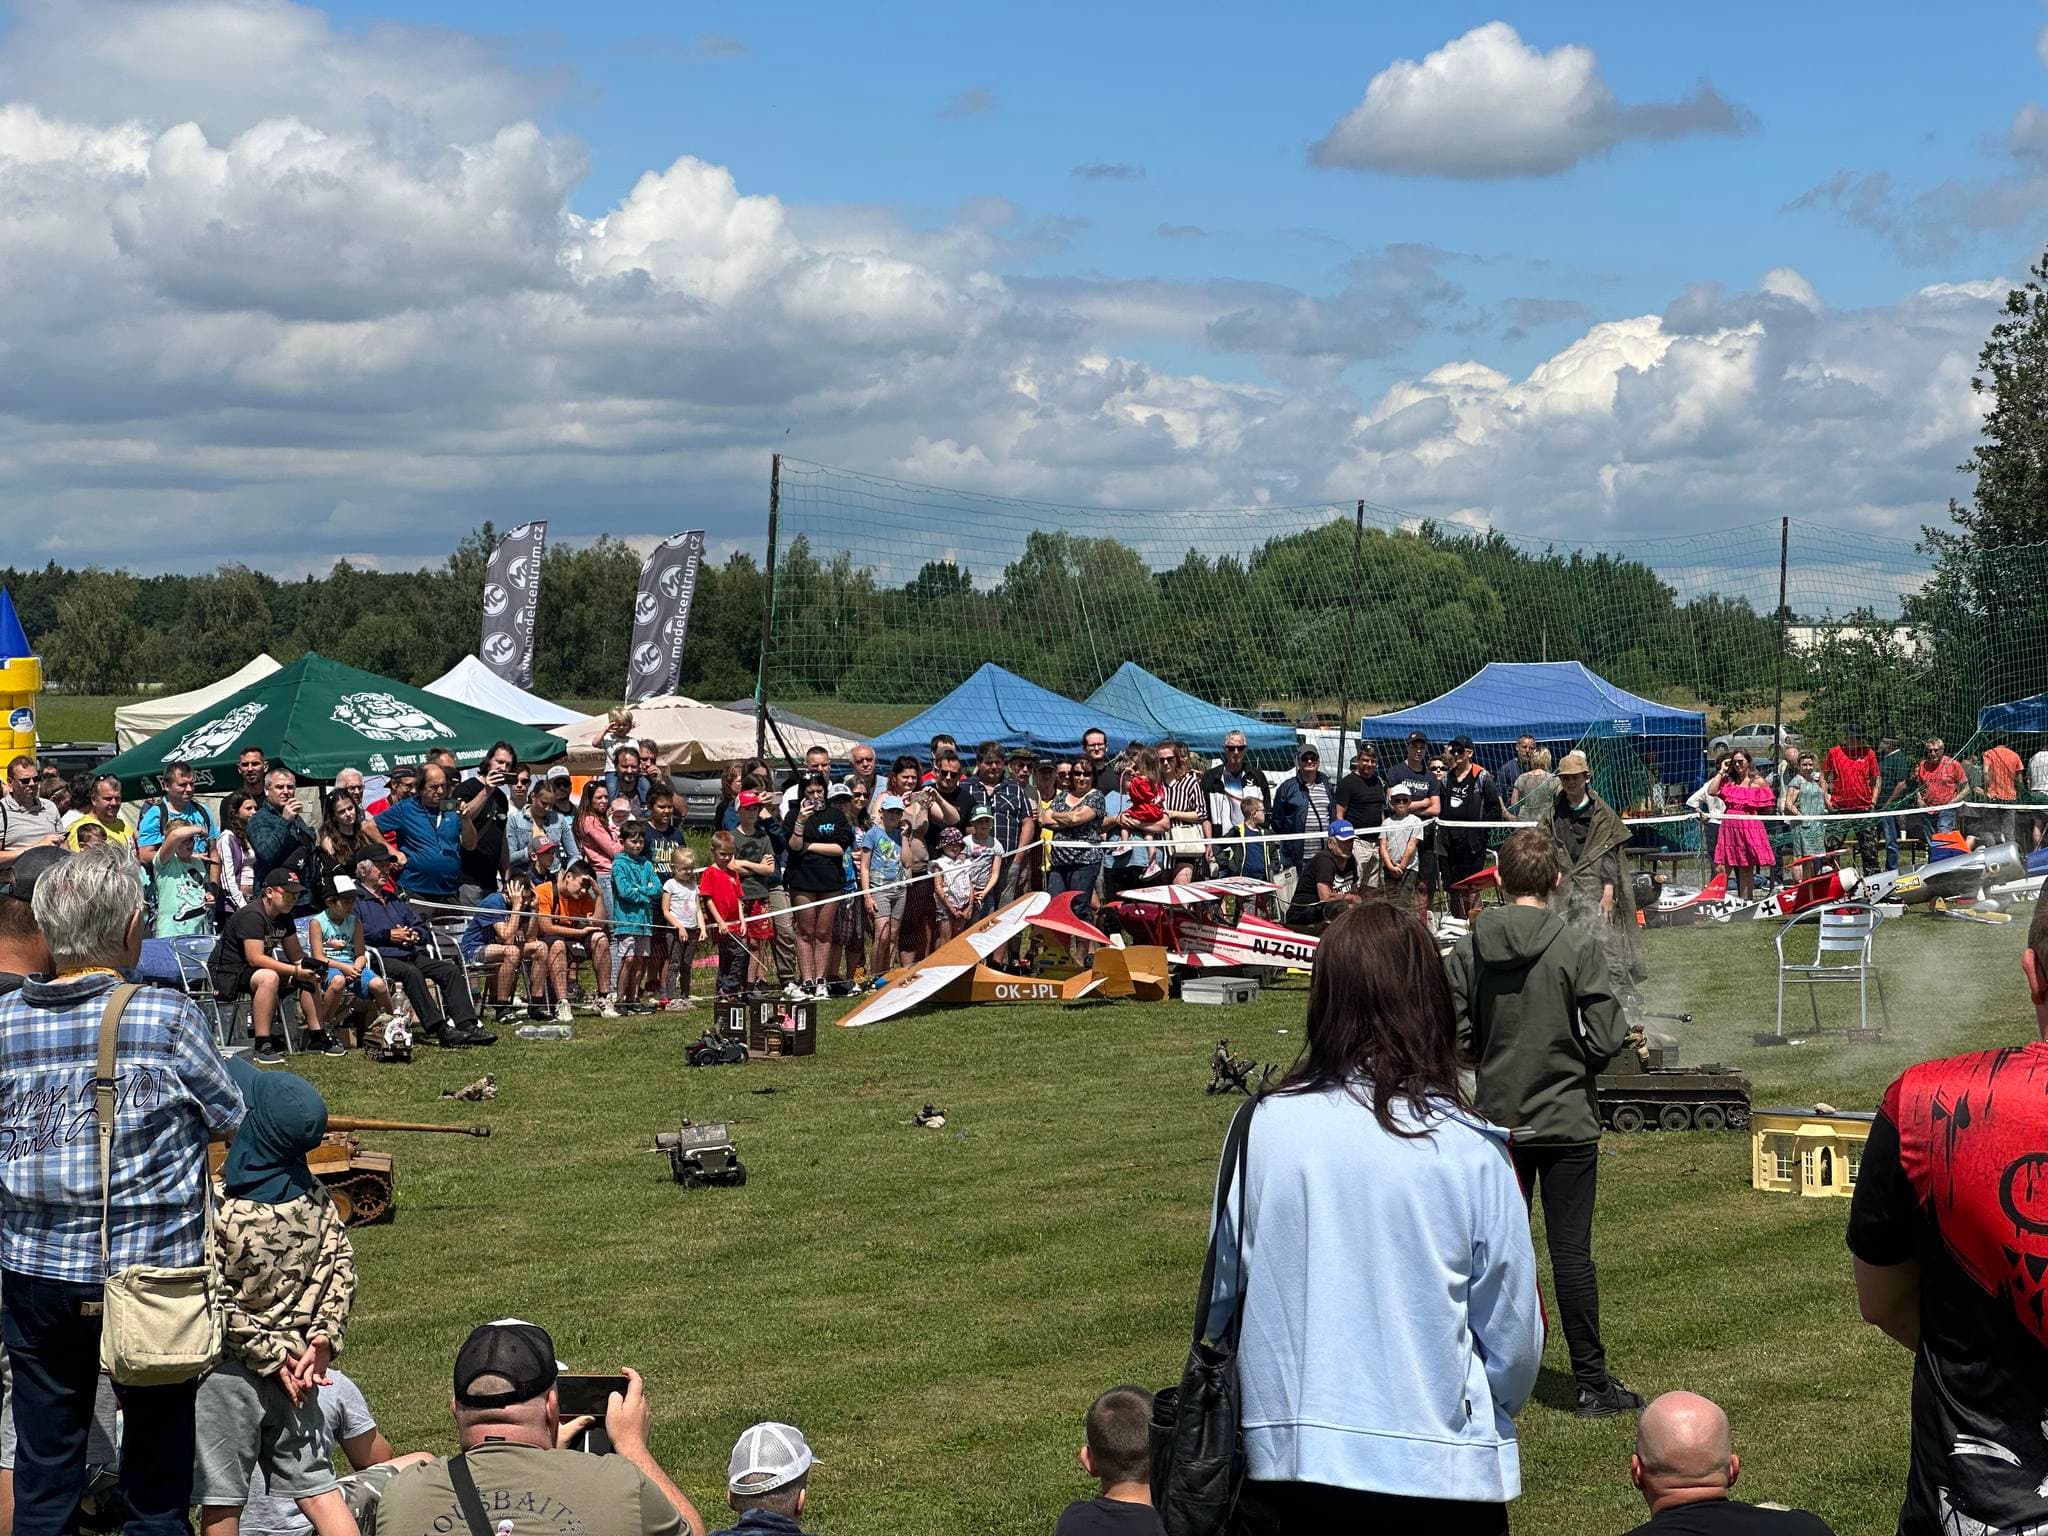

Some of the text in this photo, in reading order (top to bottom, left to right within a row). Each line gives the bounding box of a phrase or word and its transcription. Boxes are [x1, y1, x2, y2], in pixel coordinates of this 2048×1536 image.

[522, 526, 543, 683] www.modelcentrum.cz
[667, 536, 700, 695] www.modelcentrum.cz
[394, 755, 416, 765] ŽIVOT
[455, 749, 489, 761] BOHUDÍ
[995, 984, 1058, 999] OK-JPL
